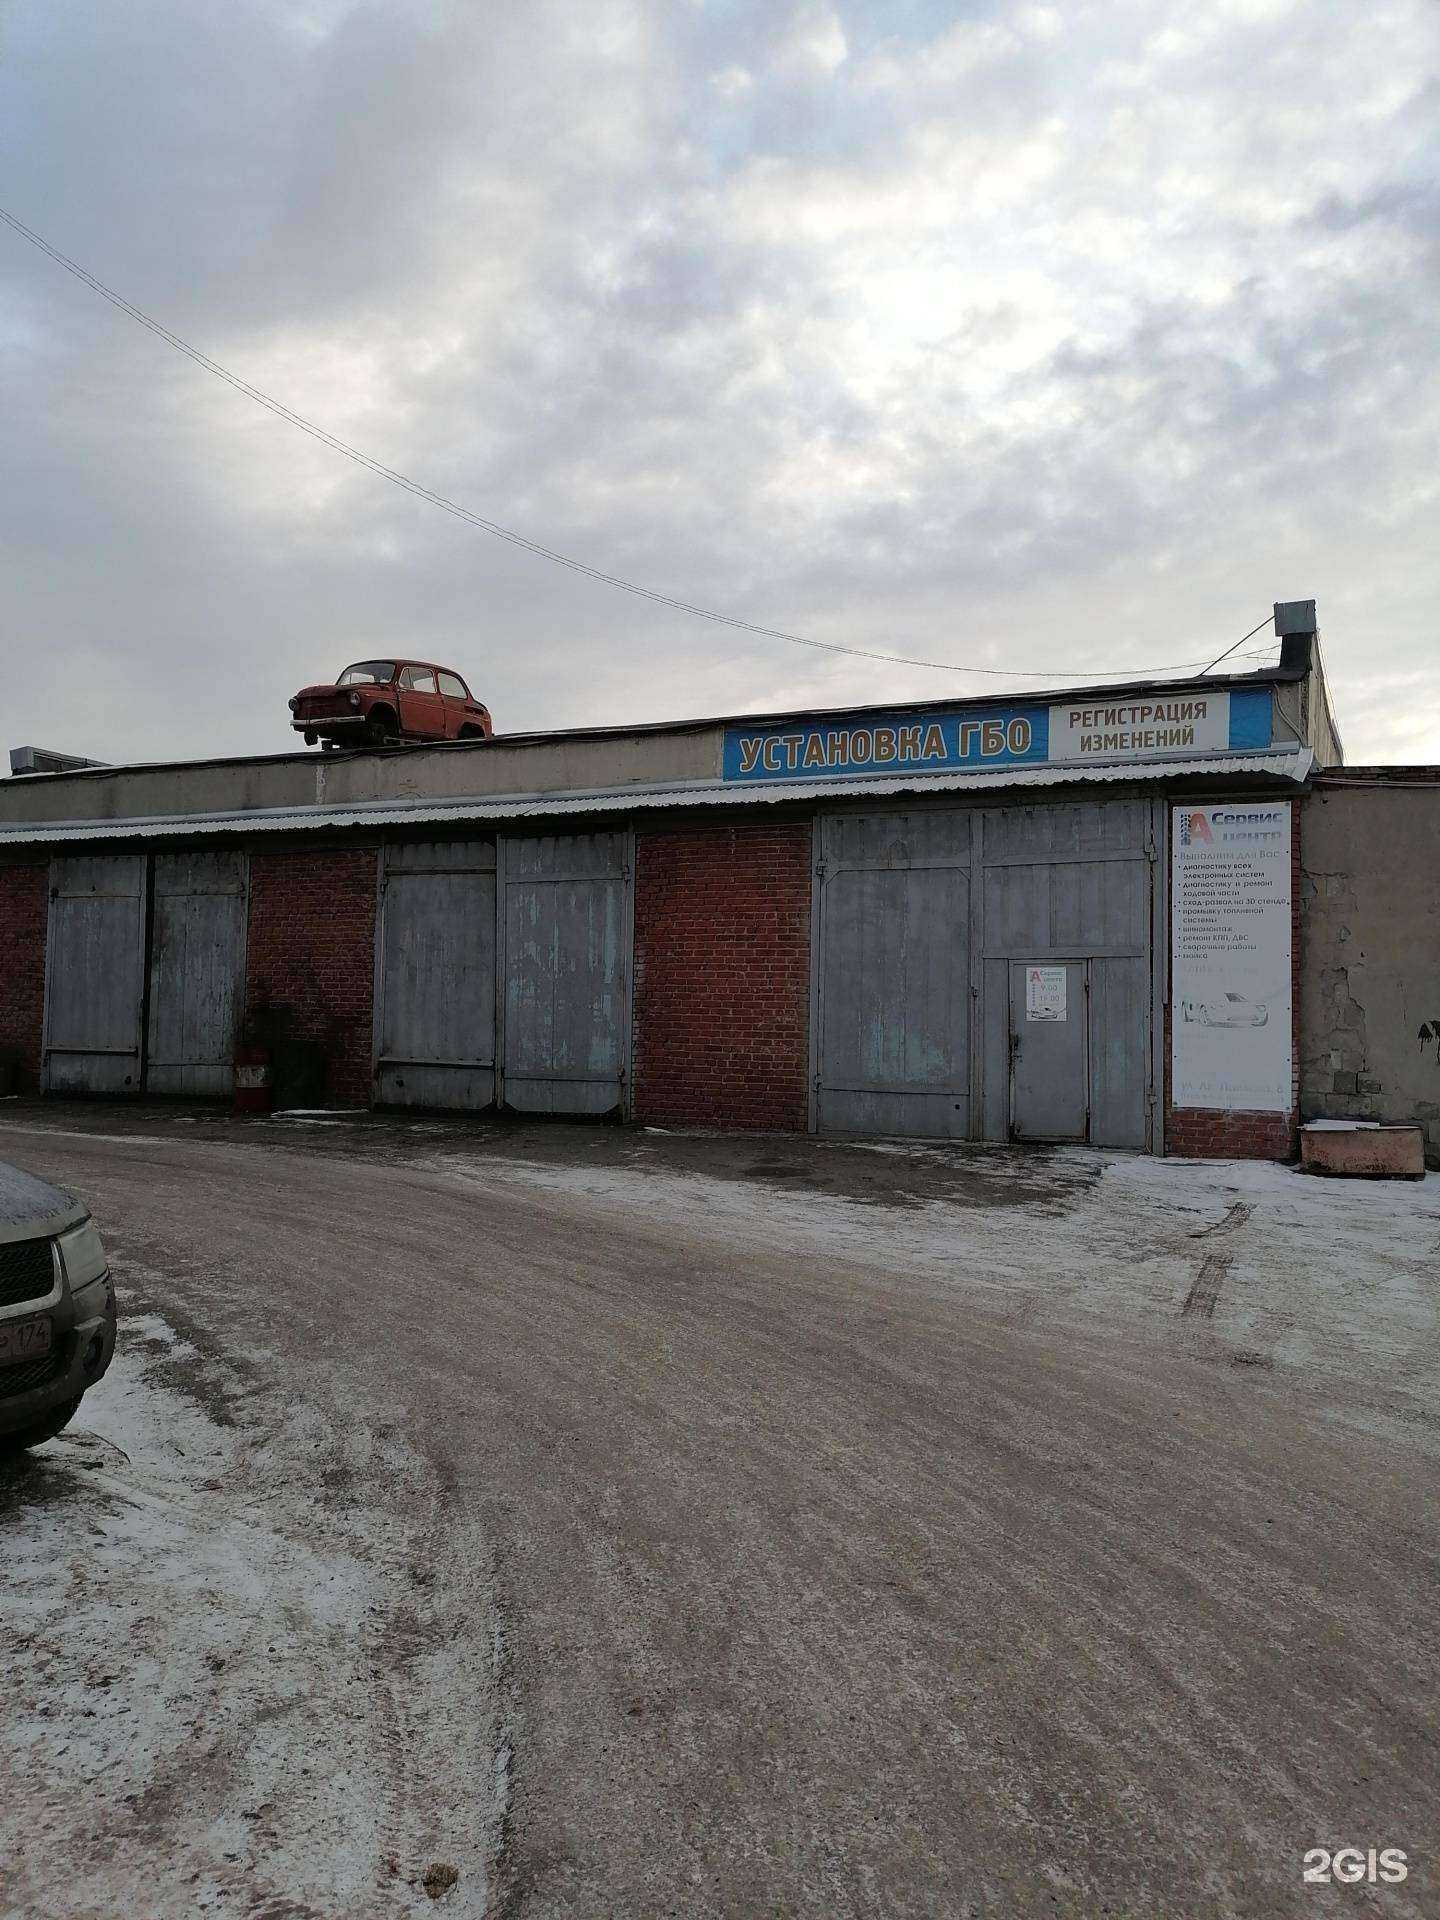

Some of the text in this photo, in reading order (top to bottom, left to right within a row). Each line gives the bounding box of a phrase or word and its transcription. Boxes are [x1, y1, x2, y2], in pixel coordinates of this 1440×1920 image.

[1069, 701, 1207, 729] РЕГИСТРАЦИЯ
[740, 718, 1031, 772] УСТАНОВКА ГБО
[1080, 725, 1194, 752] ИЗМЕНЕНИЙ
